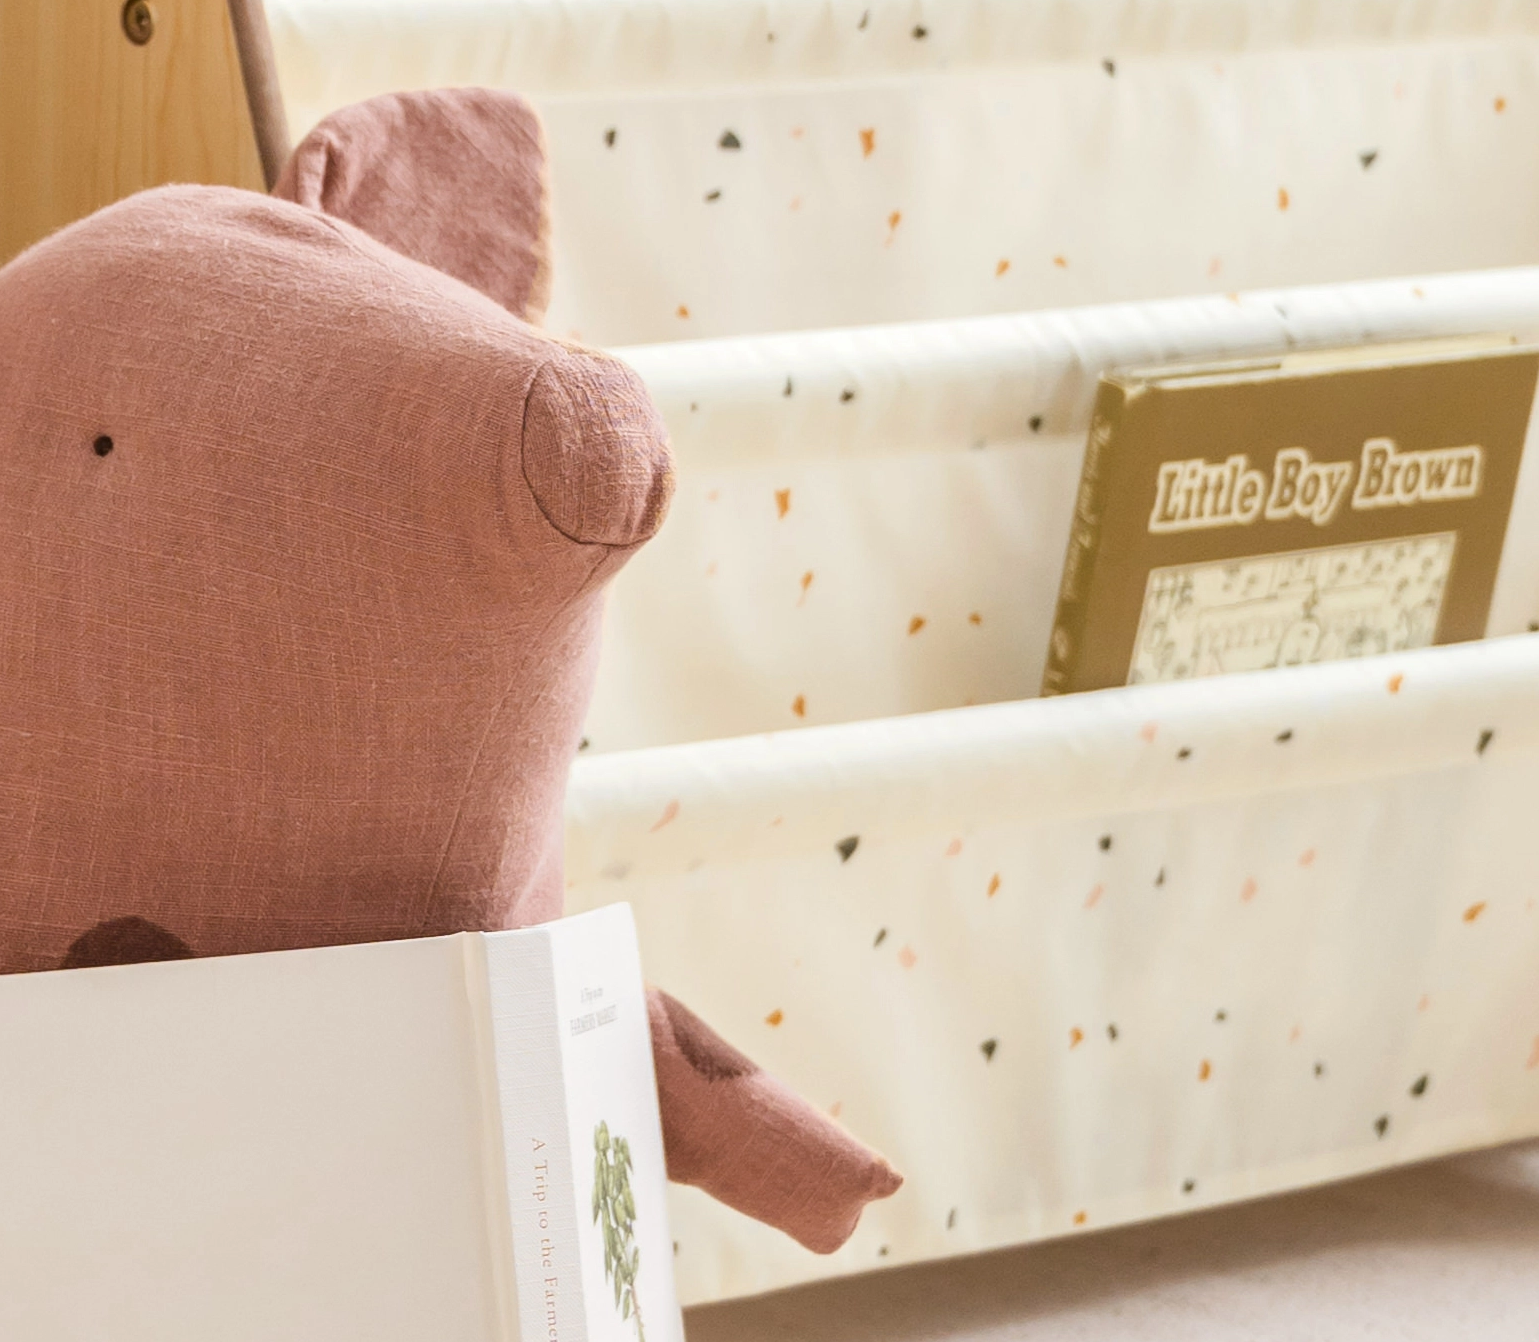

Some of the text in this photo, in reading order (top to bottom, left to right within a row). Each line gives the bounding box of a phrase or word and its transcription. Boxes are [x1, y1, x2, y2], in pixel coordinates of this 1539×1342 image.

[1149, 455, 1265, 532] Little
[1265, 448, 1352, 526] Boy
[1352, 438, 1483, 509] Brown
[531, 1137, 547, 1153] A
[533, 1159, 549, 1202] Trip
[538, 1210, 549, 1229] to
[540, 1238, 555, 1267] the
